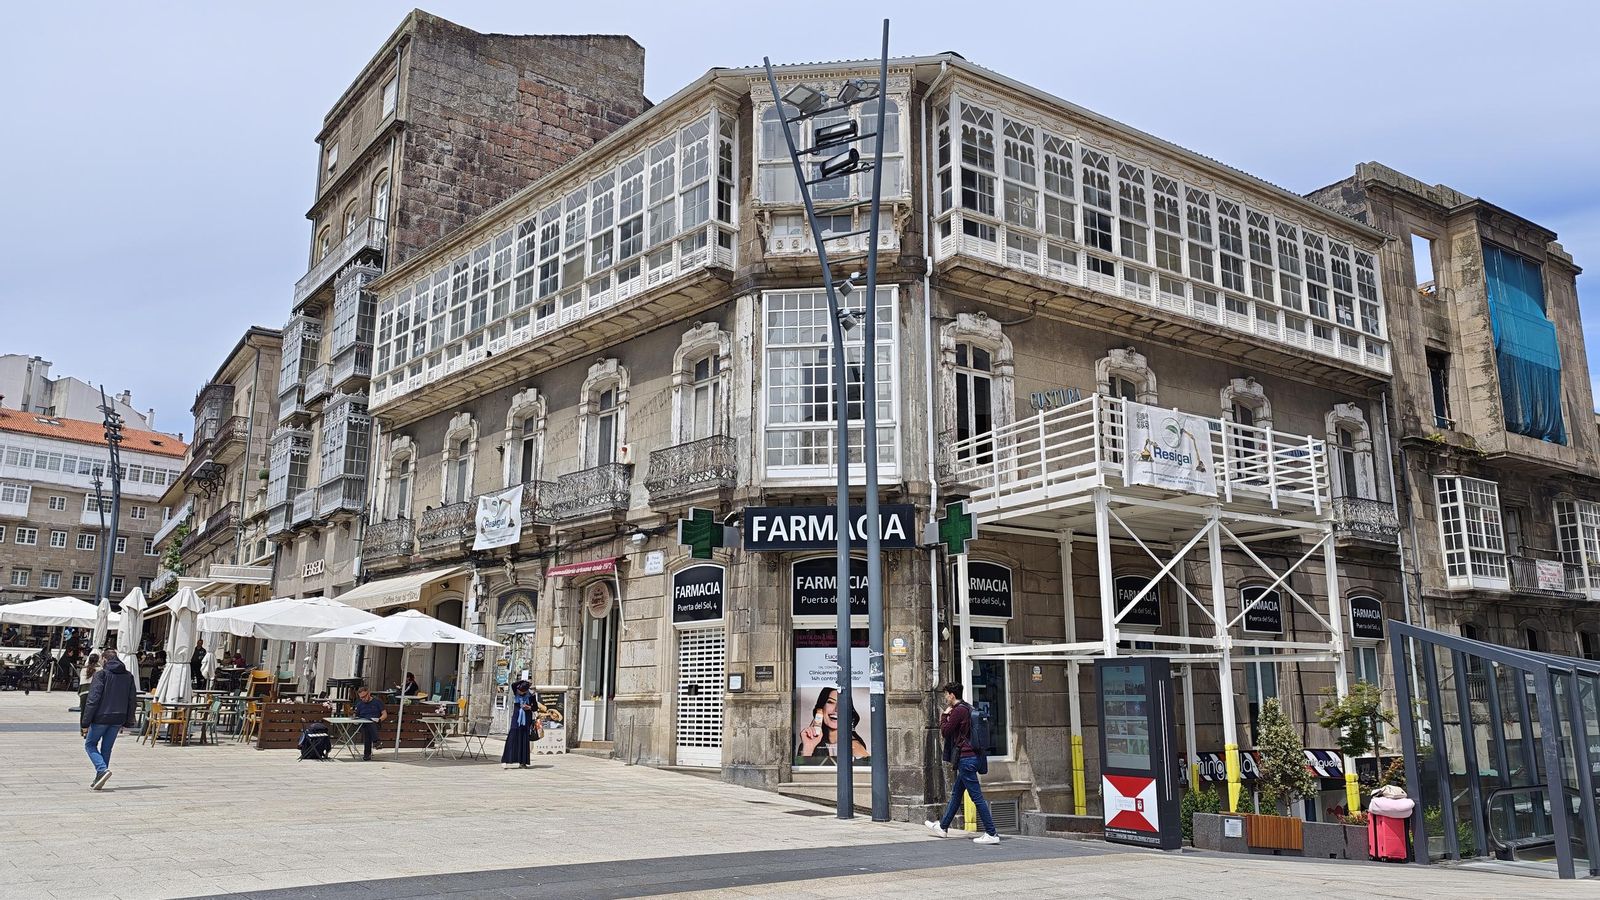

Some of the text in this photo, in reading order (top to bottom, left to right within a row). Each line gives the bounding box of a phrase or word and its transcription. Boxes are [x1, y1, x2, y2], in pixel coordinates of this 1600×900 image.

[1030, 388, 1081, 410] COSTURA
[1153, 446, 1192, 466] Resigal
[485, 516, 506, 528] Resigal
[797, 576, 869, 590] FARMCIA
[675, 581, 721, 599] FARMACIA
[677, 604, 694, 612] Puerta
[694, 601, 703, 610] del
[713, 602, 717, 610] 4
[801, 595, 828, 604] Puerta
[849, 595, 859, 605] ol,
[861, 597, 866, 605] 4
[1353, 608, 1381, 619] FARMACIA
